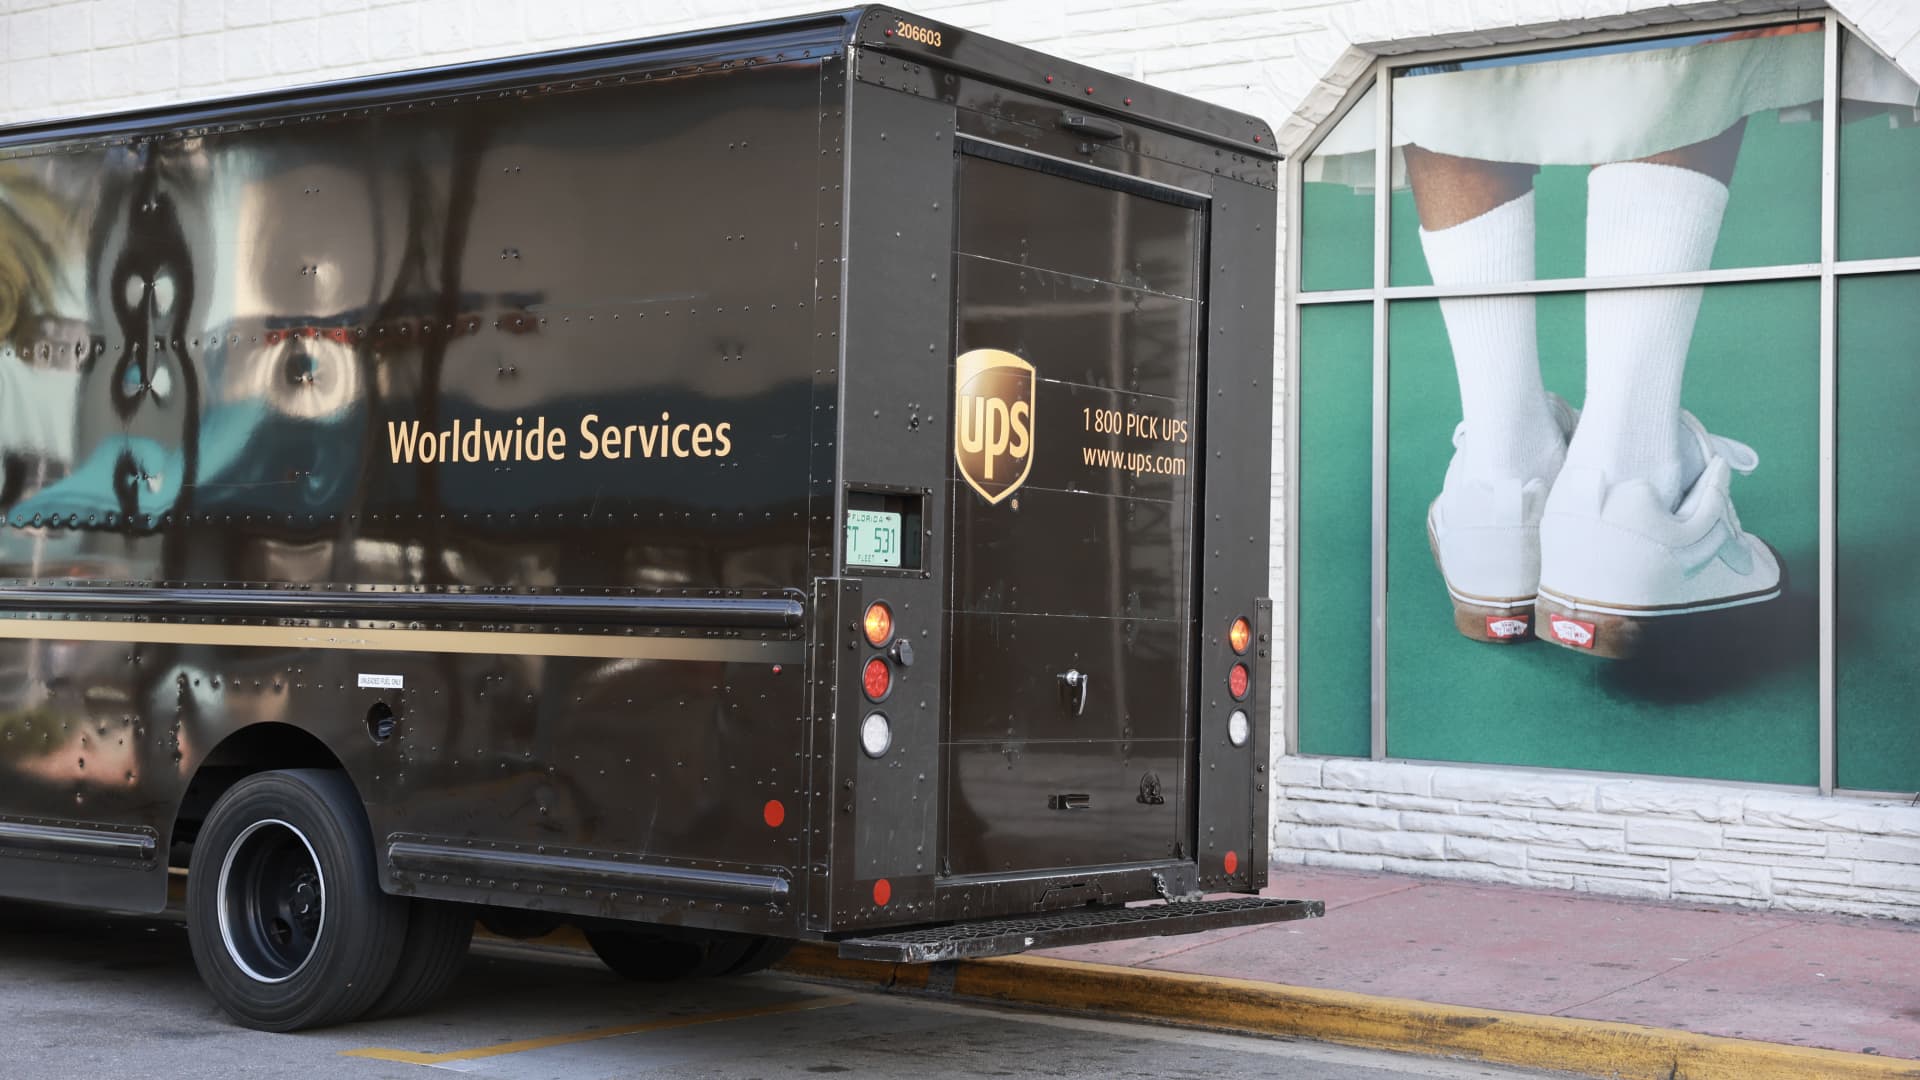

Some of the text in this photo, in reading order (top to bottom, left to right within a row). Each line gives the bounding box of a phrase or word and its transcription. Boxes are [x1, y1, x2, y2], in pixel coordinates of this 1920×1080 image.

[897, 21, 942, 47] 206603
[387, 411, 731, 464] Worldwide Services
[960, 395, 1029, 480] ups
[1083, 407, 1188, 443] 1 800 PICK UPS
[1082, 446, 1186, 478] www.ups.com
[852, 512, 884, 523] FLORIDA
[874, 527, 895, 553] 531
